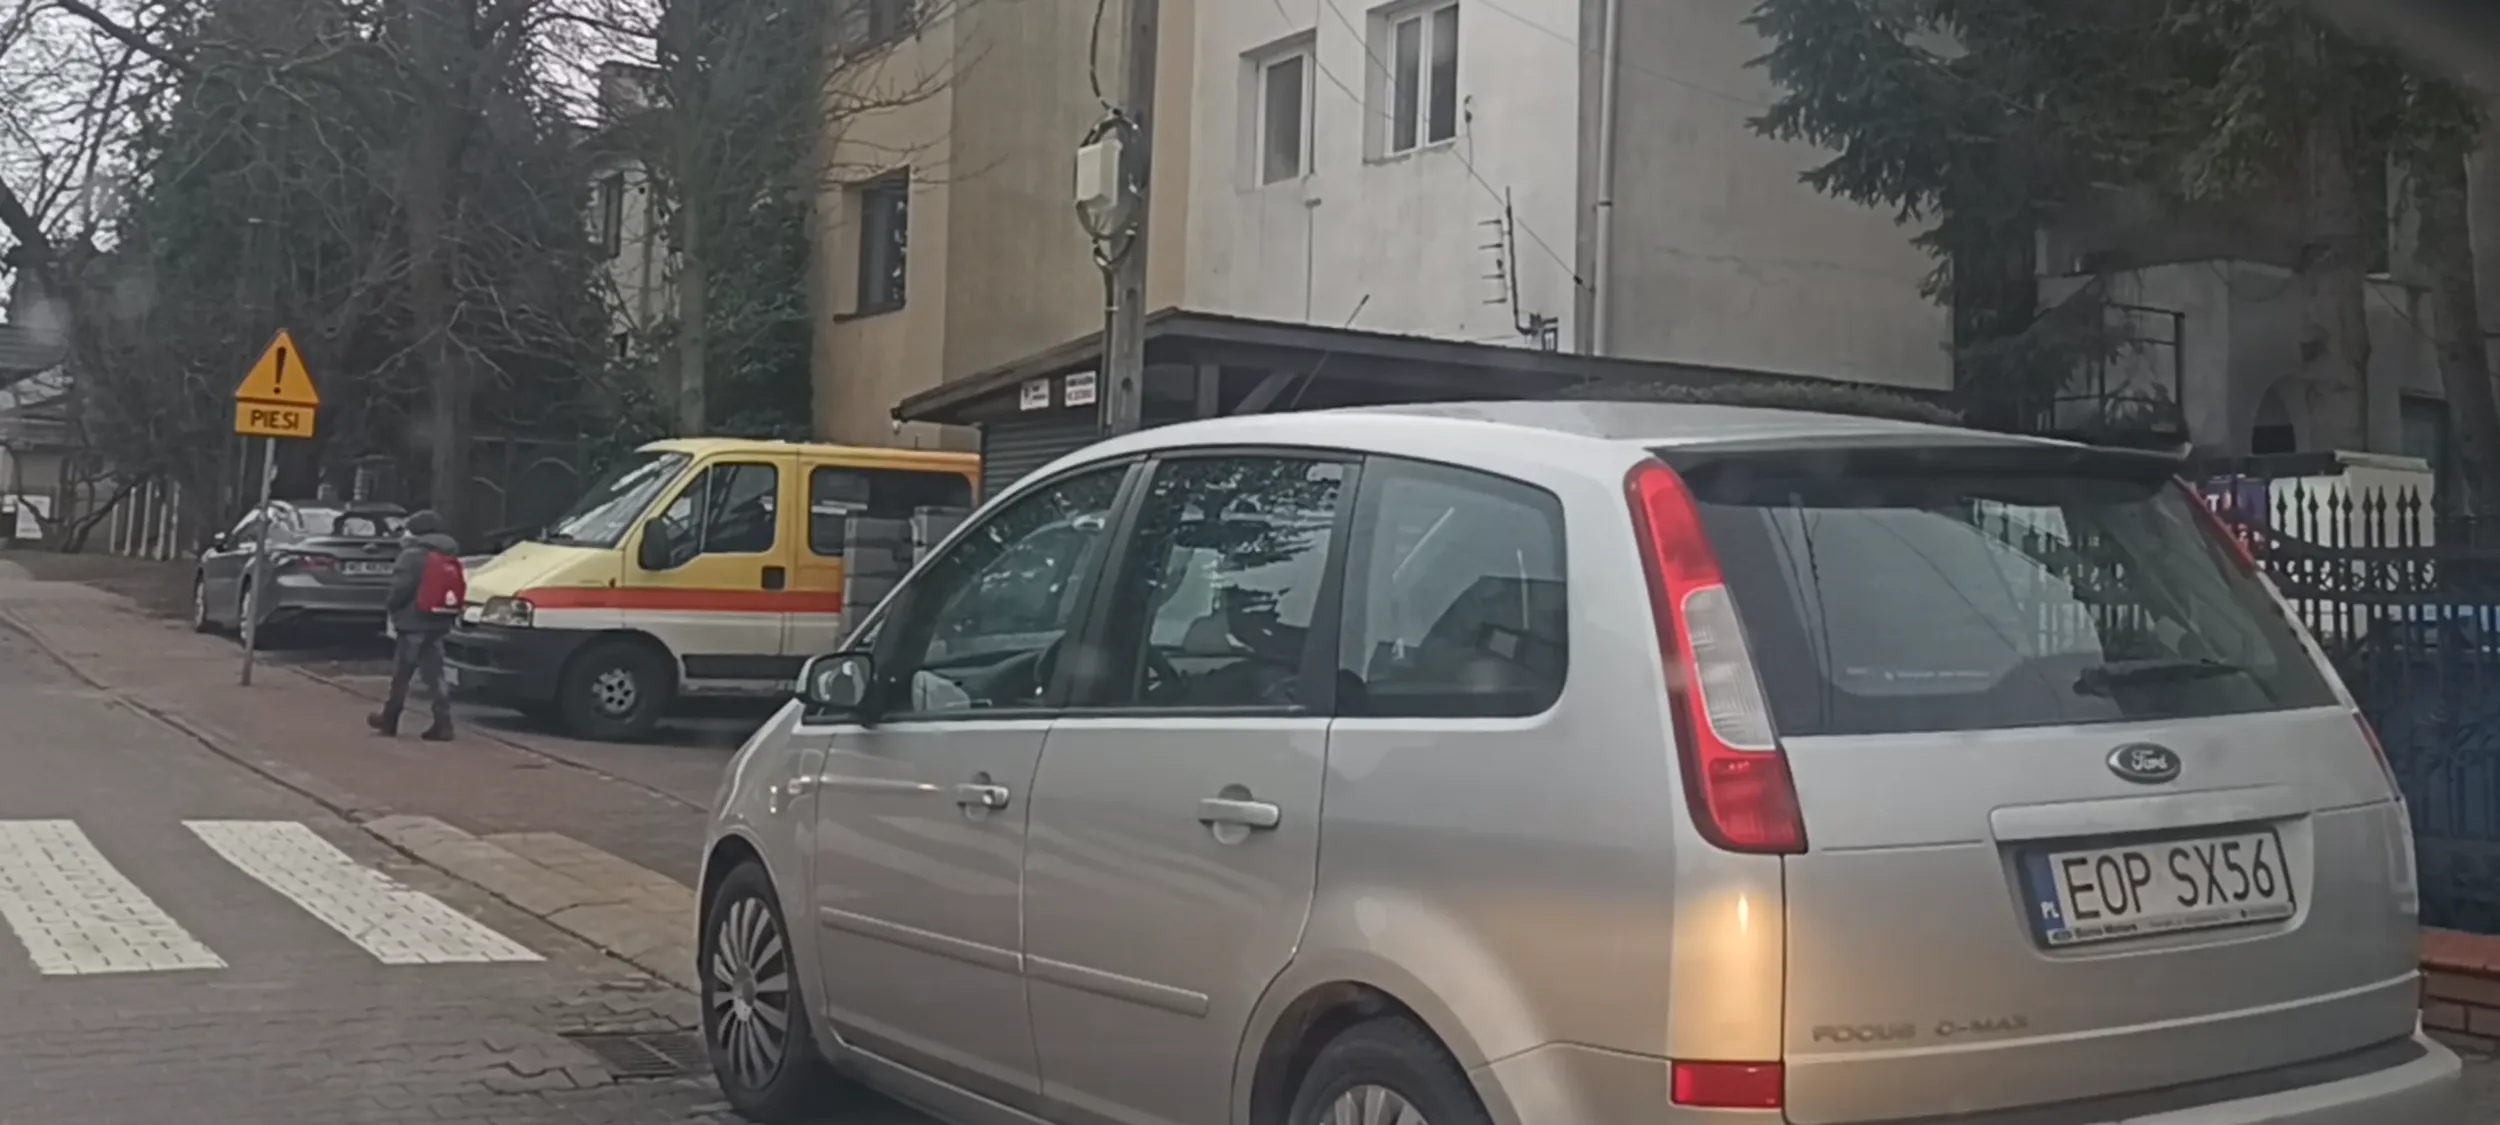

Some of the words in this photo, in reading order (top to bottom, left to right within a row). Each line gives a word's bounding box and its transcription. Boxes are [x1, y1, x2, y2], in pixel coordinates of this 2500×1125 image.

[251, 409, 299, 430] PIESI
[2131, 749, 2168, 770] Ford
[2062, 852, 2151, 920] EOP
[2168, 838, 2275, 907] SX56
[2041, 901, 2060, 919] PL
[1812, 1023, 1916, 1042] FOCUS
[1935, 1014, 2028, 1036] C-MAX
